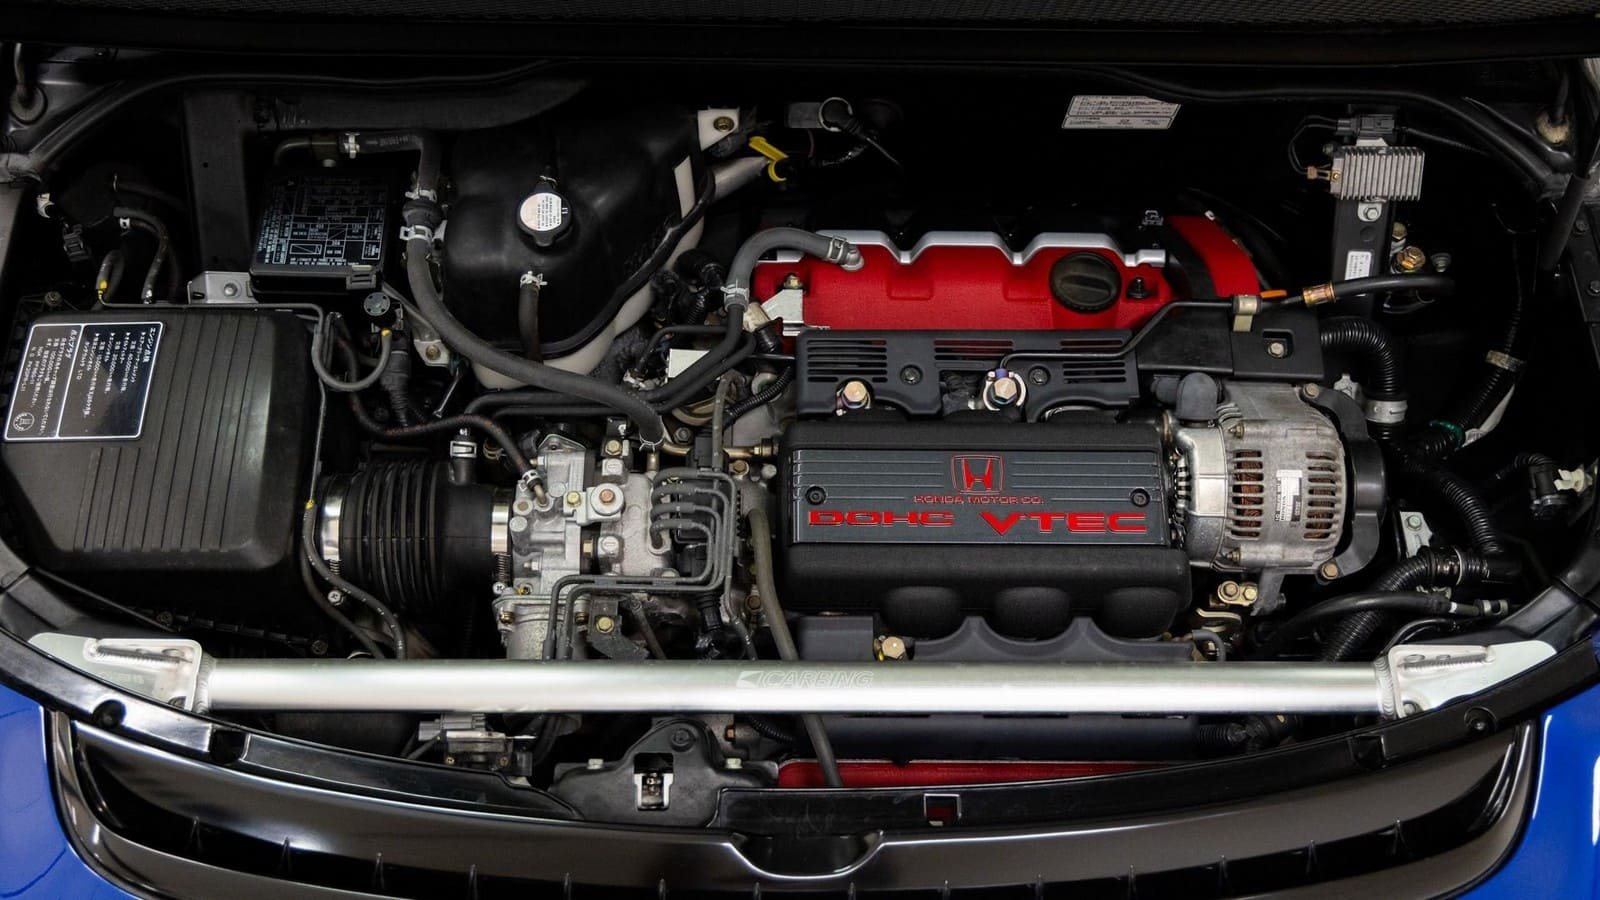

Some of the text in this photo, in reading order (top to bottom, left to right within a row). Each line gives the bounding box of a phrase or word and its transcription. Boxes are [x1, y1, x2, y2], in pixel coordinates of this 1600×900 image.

[913, 495, 1045, 505] HONDA MOTOR CO.
[807, 510, 1148, 537] DOHC VTEC
[761, 670, 874, 689] CARBING
